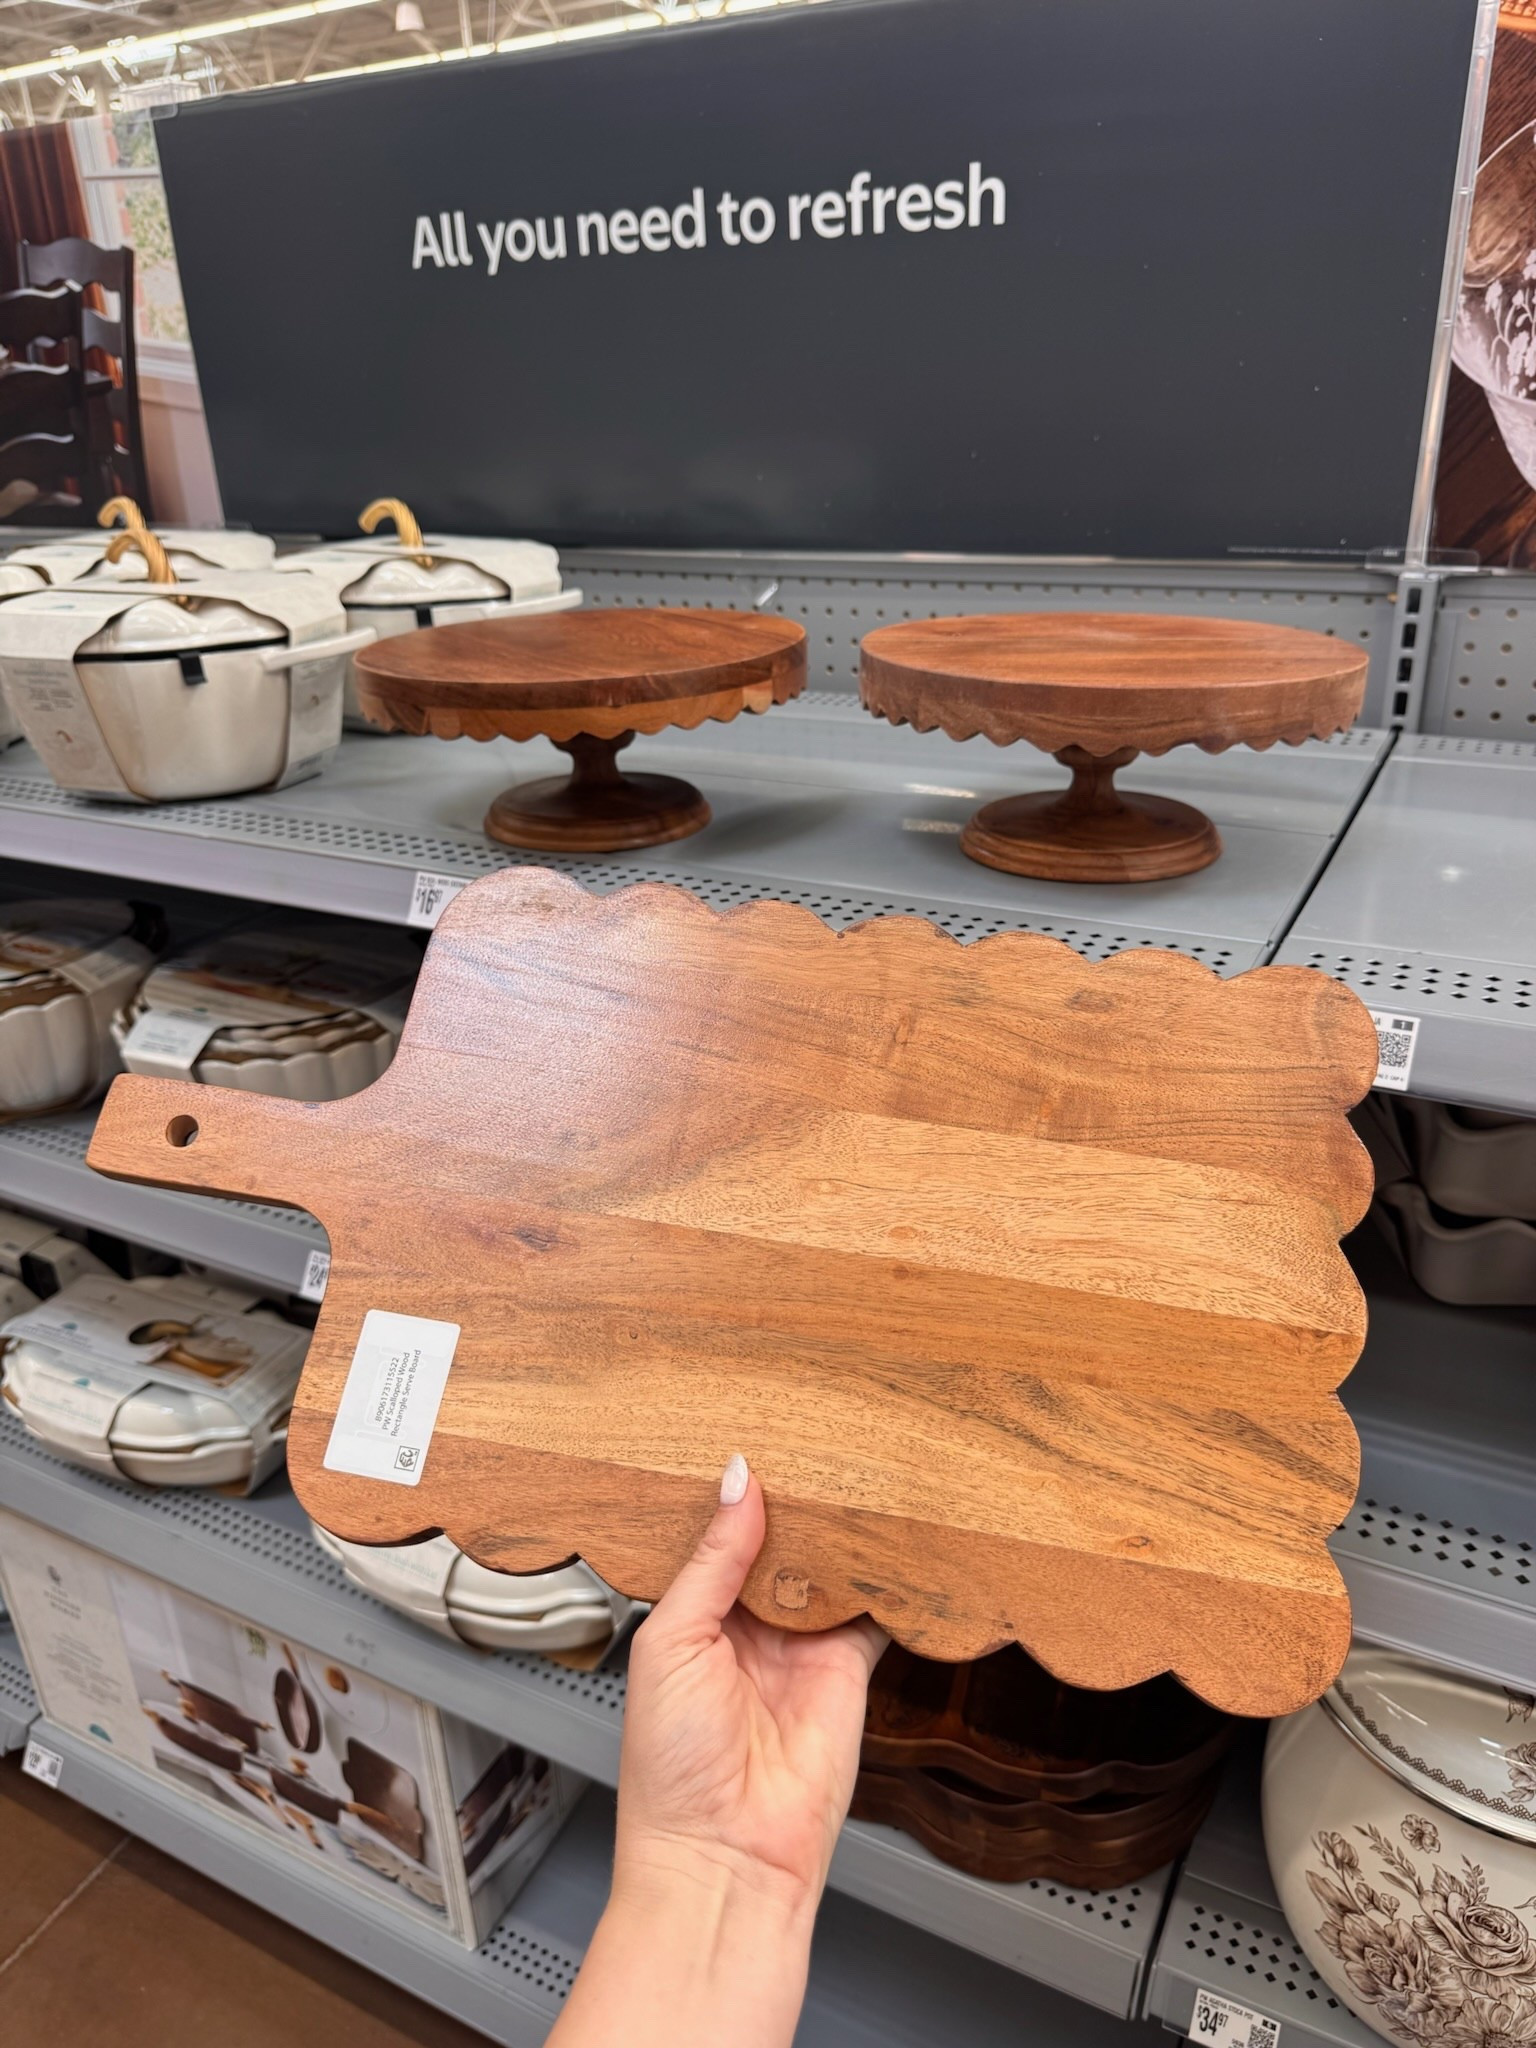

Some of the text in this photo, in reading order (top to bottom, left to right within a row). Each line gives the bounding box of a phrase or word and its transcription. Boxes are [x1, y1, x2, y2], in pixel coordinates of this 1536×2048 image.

[412, 161, 1006, 277] All you need to refresh
[382, 1352, 411, 1431] PW Scalloped Wood
[390, 1349, 422, 1437] Rectangle Serve Board
